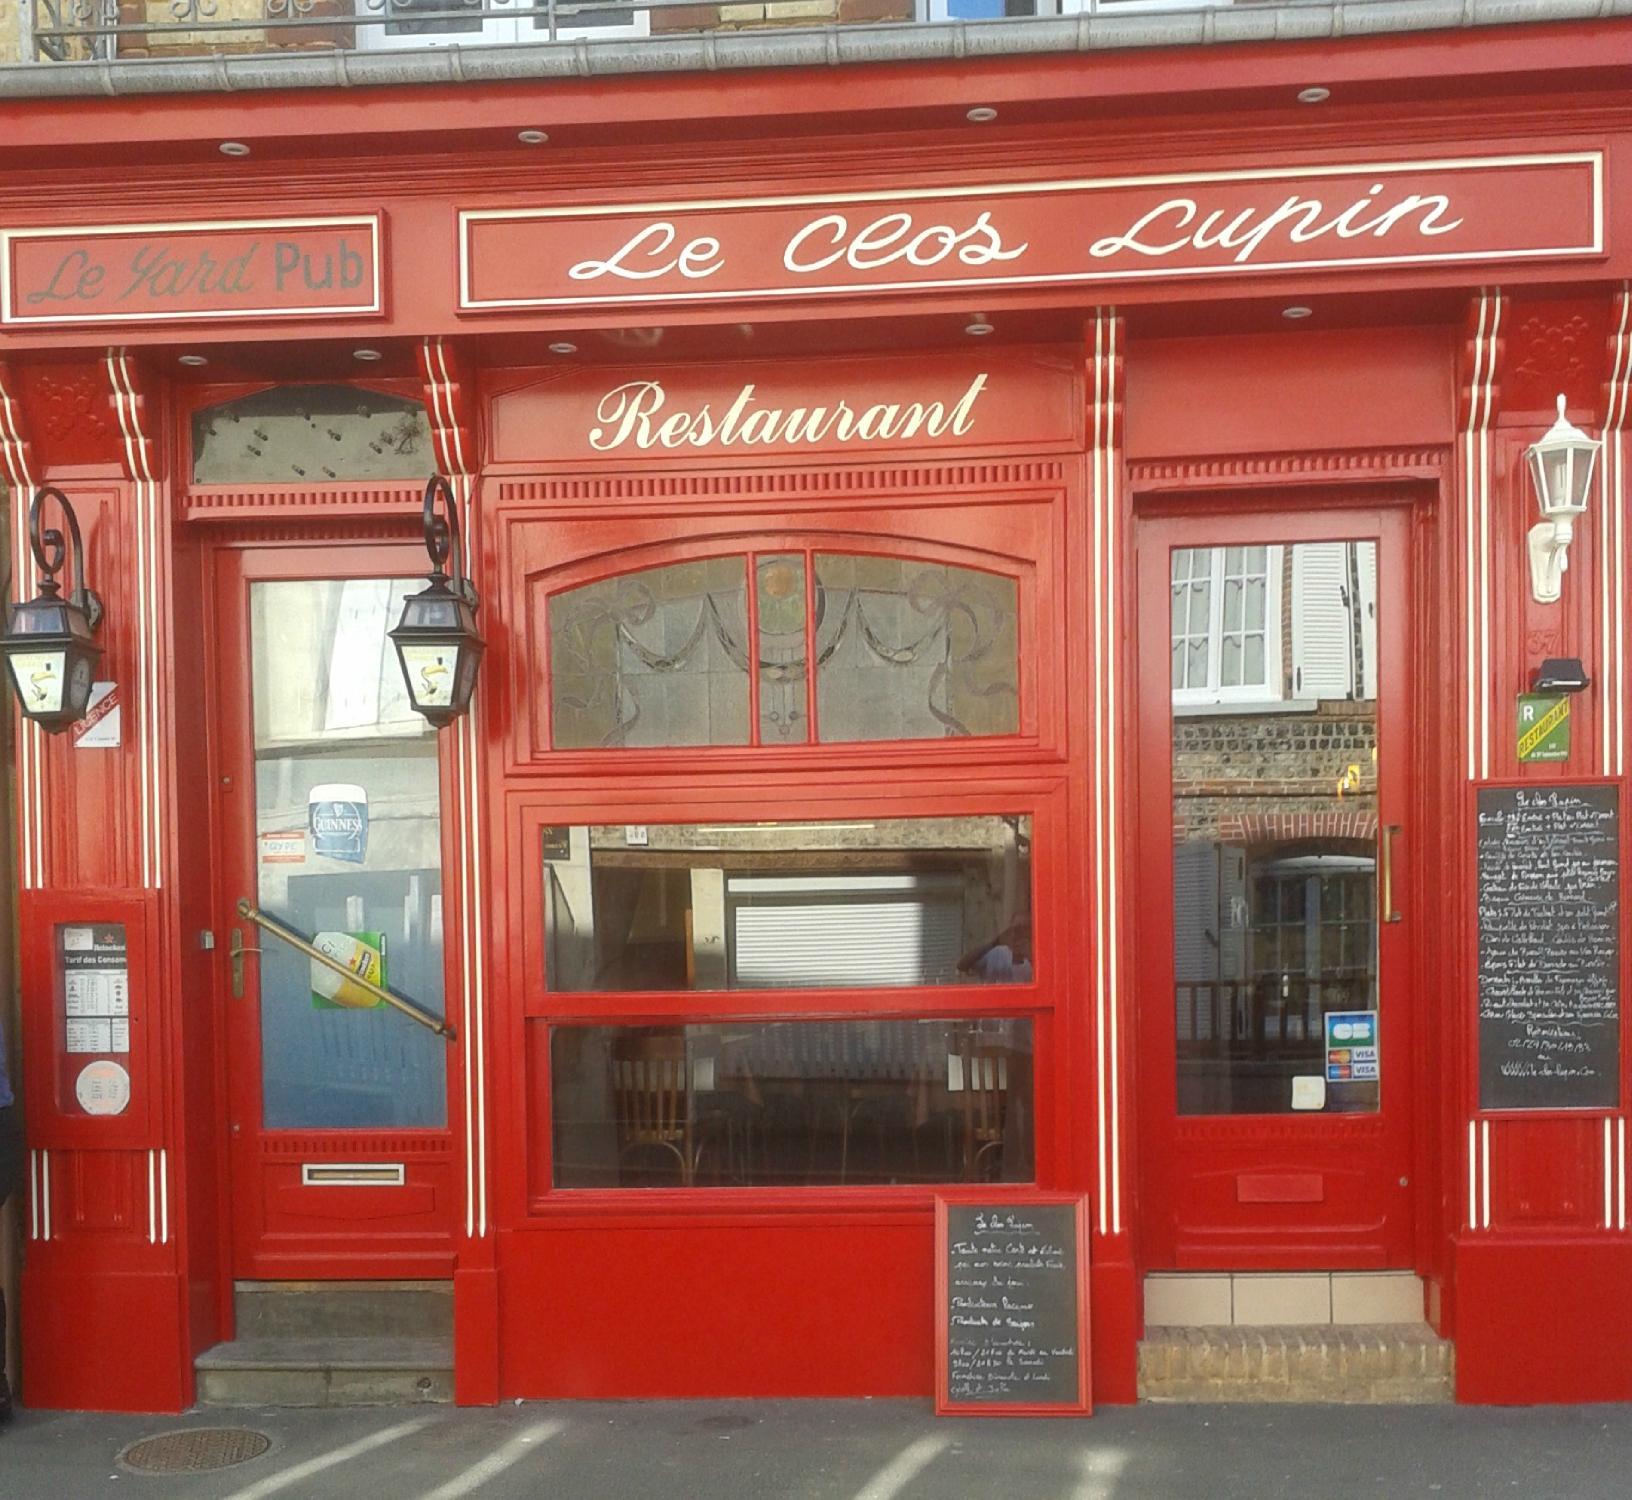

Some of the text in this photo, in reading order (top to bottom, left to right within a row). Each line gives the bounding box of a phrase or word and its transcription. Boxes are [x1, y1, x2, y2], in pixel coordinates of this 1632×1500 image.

[568, 183, 1464, 280] Le Clos Lupin
[26, 240, 364, 304] Le Yard Pub
[589, 374, 988, 451] Restaurant
[1519, 699, 1569, 751] RESTAURANT
[1523, 705, 1534, 721] R
[315, 816, 362, 832] GUINNESS
[1354, 1050, 1376, 1058] VISA
[1354, 1066, 1377, 1074] VISA
